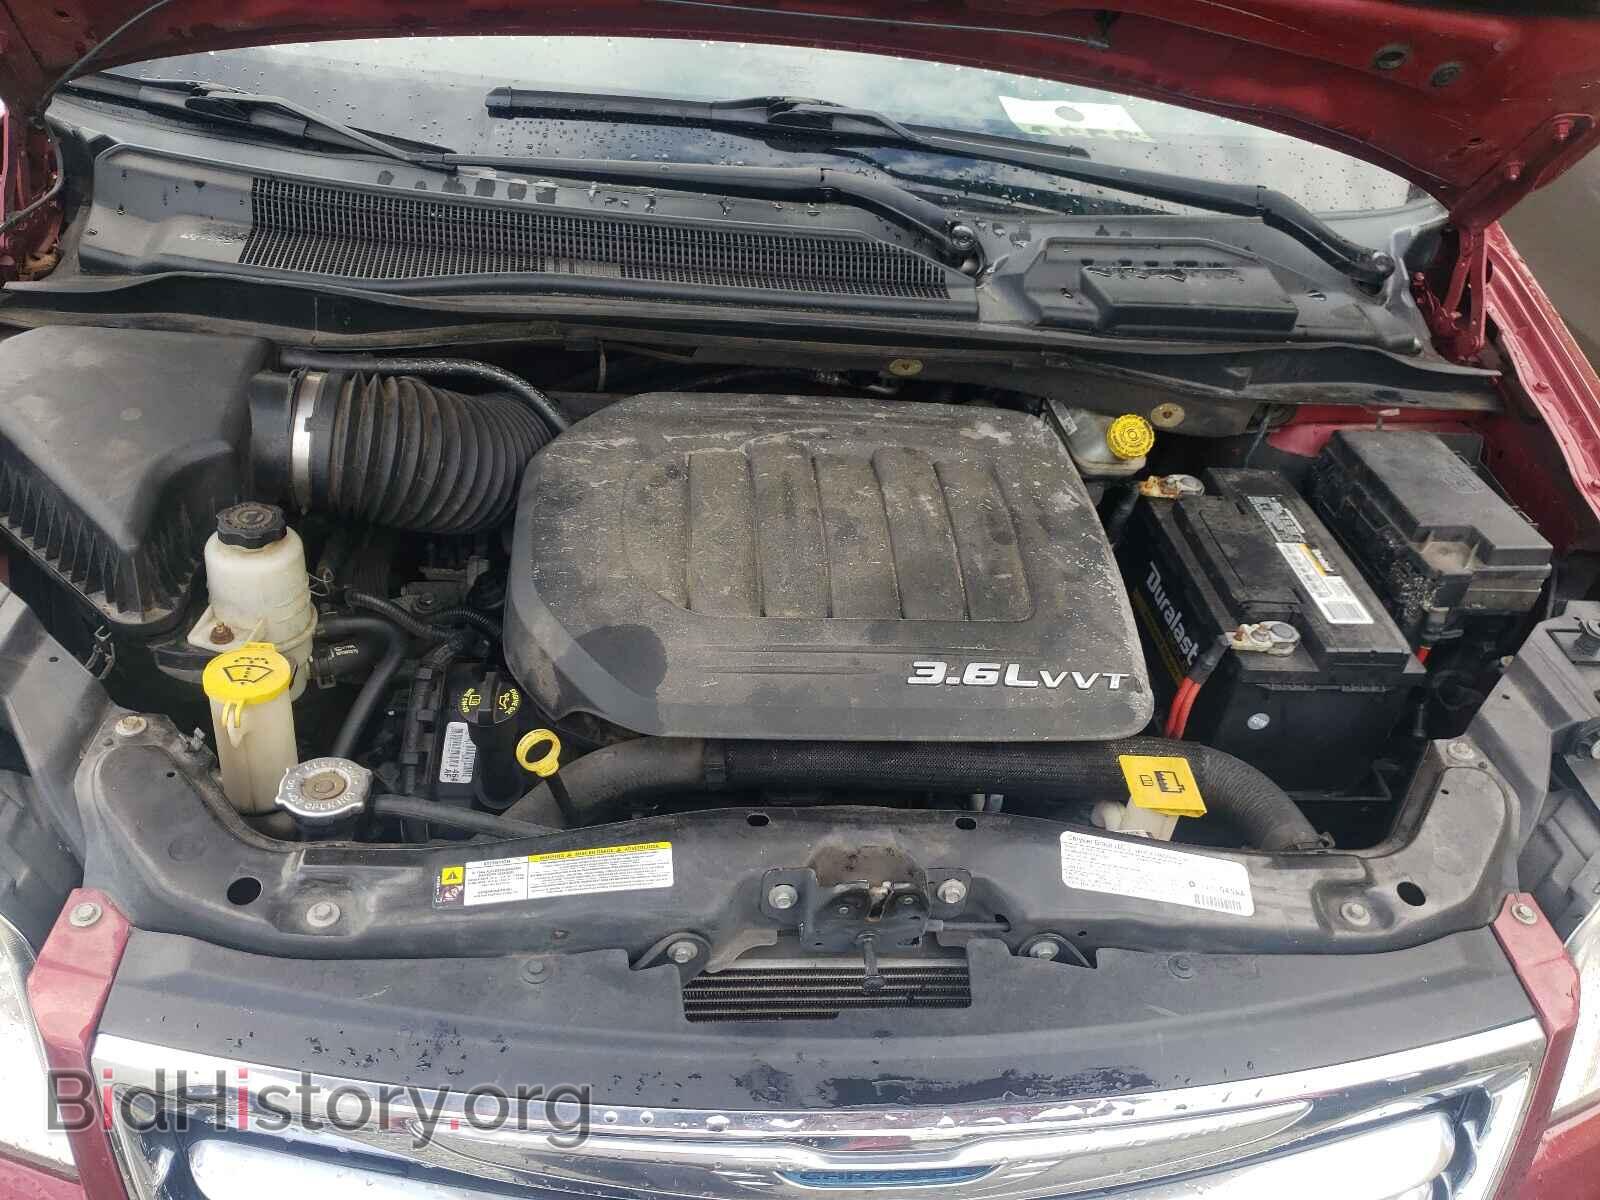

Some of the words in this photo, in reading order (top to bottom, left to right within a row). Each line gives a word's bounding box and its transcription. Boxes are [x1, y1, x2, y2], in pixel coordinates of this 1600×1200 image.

[1145, 561, 1200, 666] Duralast
[907, 661, 1039, 688] 3.6L
[1039, 671, 1130, 690] VVT
